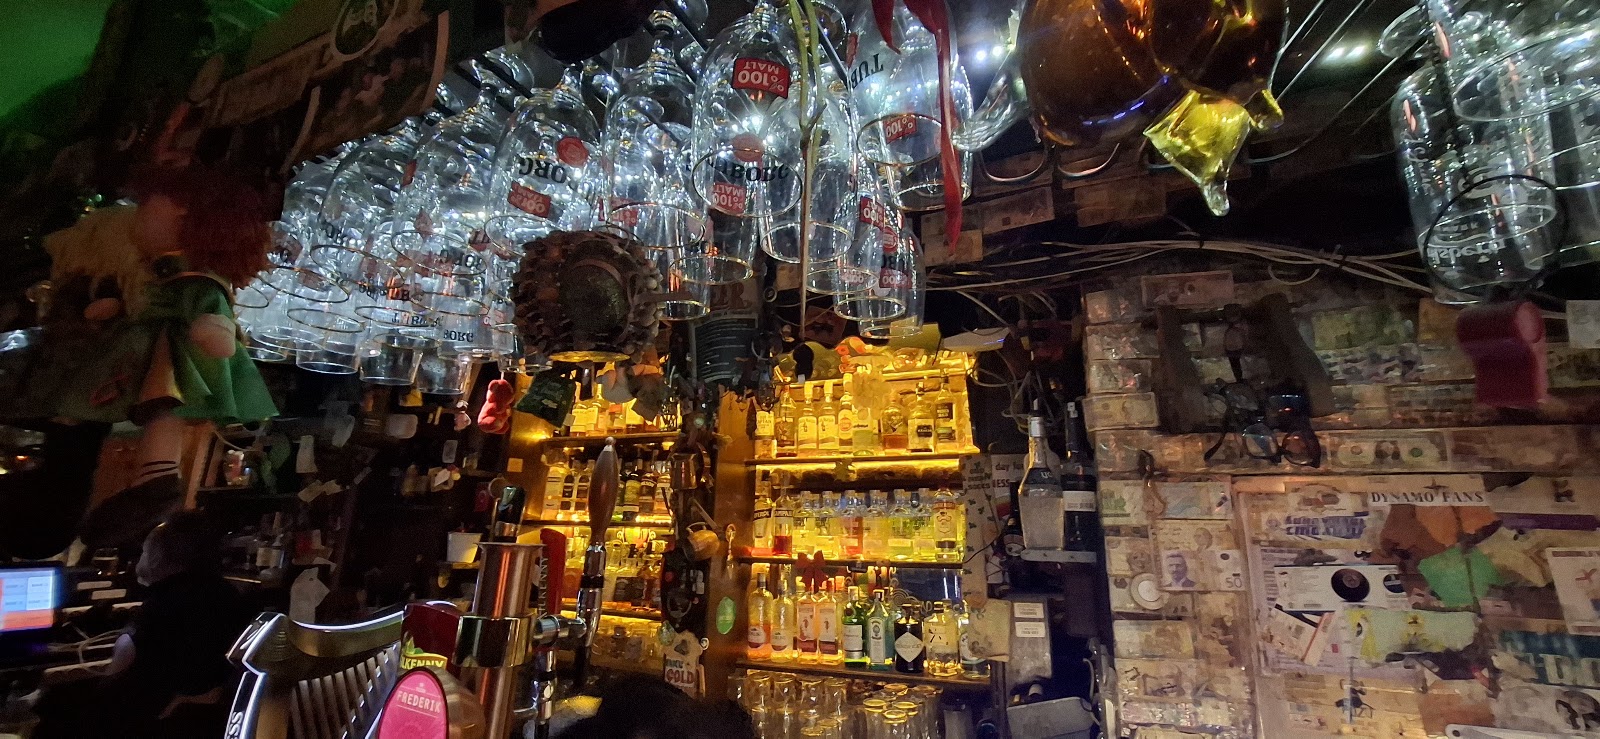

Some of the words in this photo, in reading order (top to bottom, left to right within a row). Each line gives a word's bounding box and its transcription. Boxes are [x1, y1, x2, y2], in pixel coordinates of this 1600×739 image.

[743, 60, 780, 75] MALT
[1371, 492, 1435, 503] DYNAMO
[1442, 492, 1484, 503] FANS
[396, 690, 442, 714] FREDERIK
